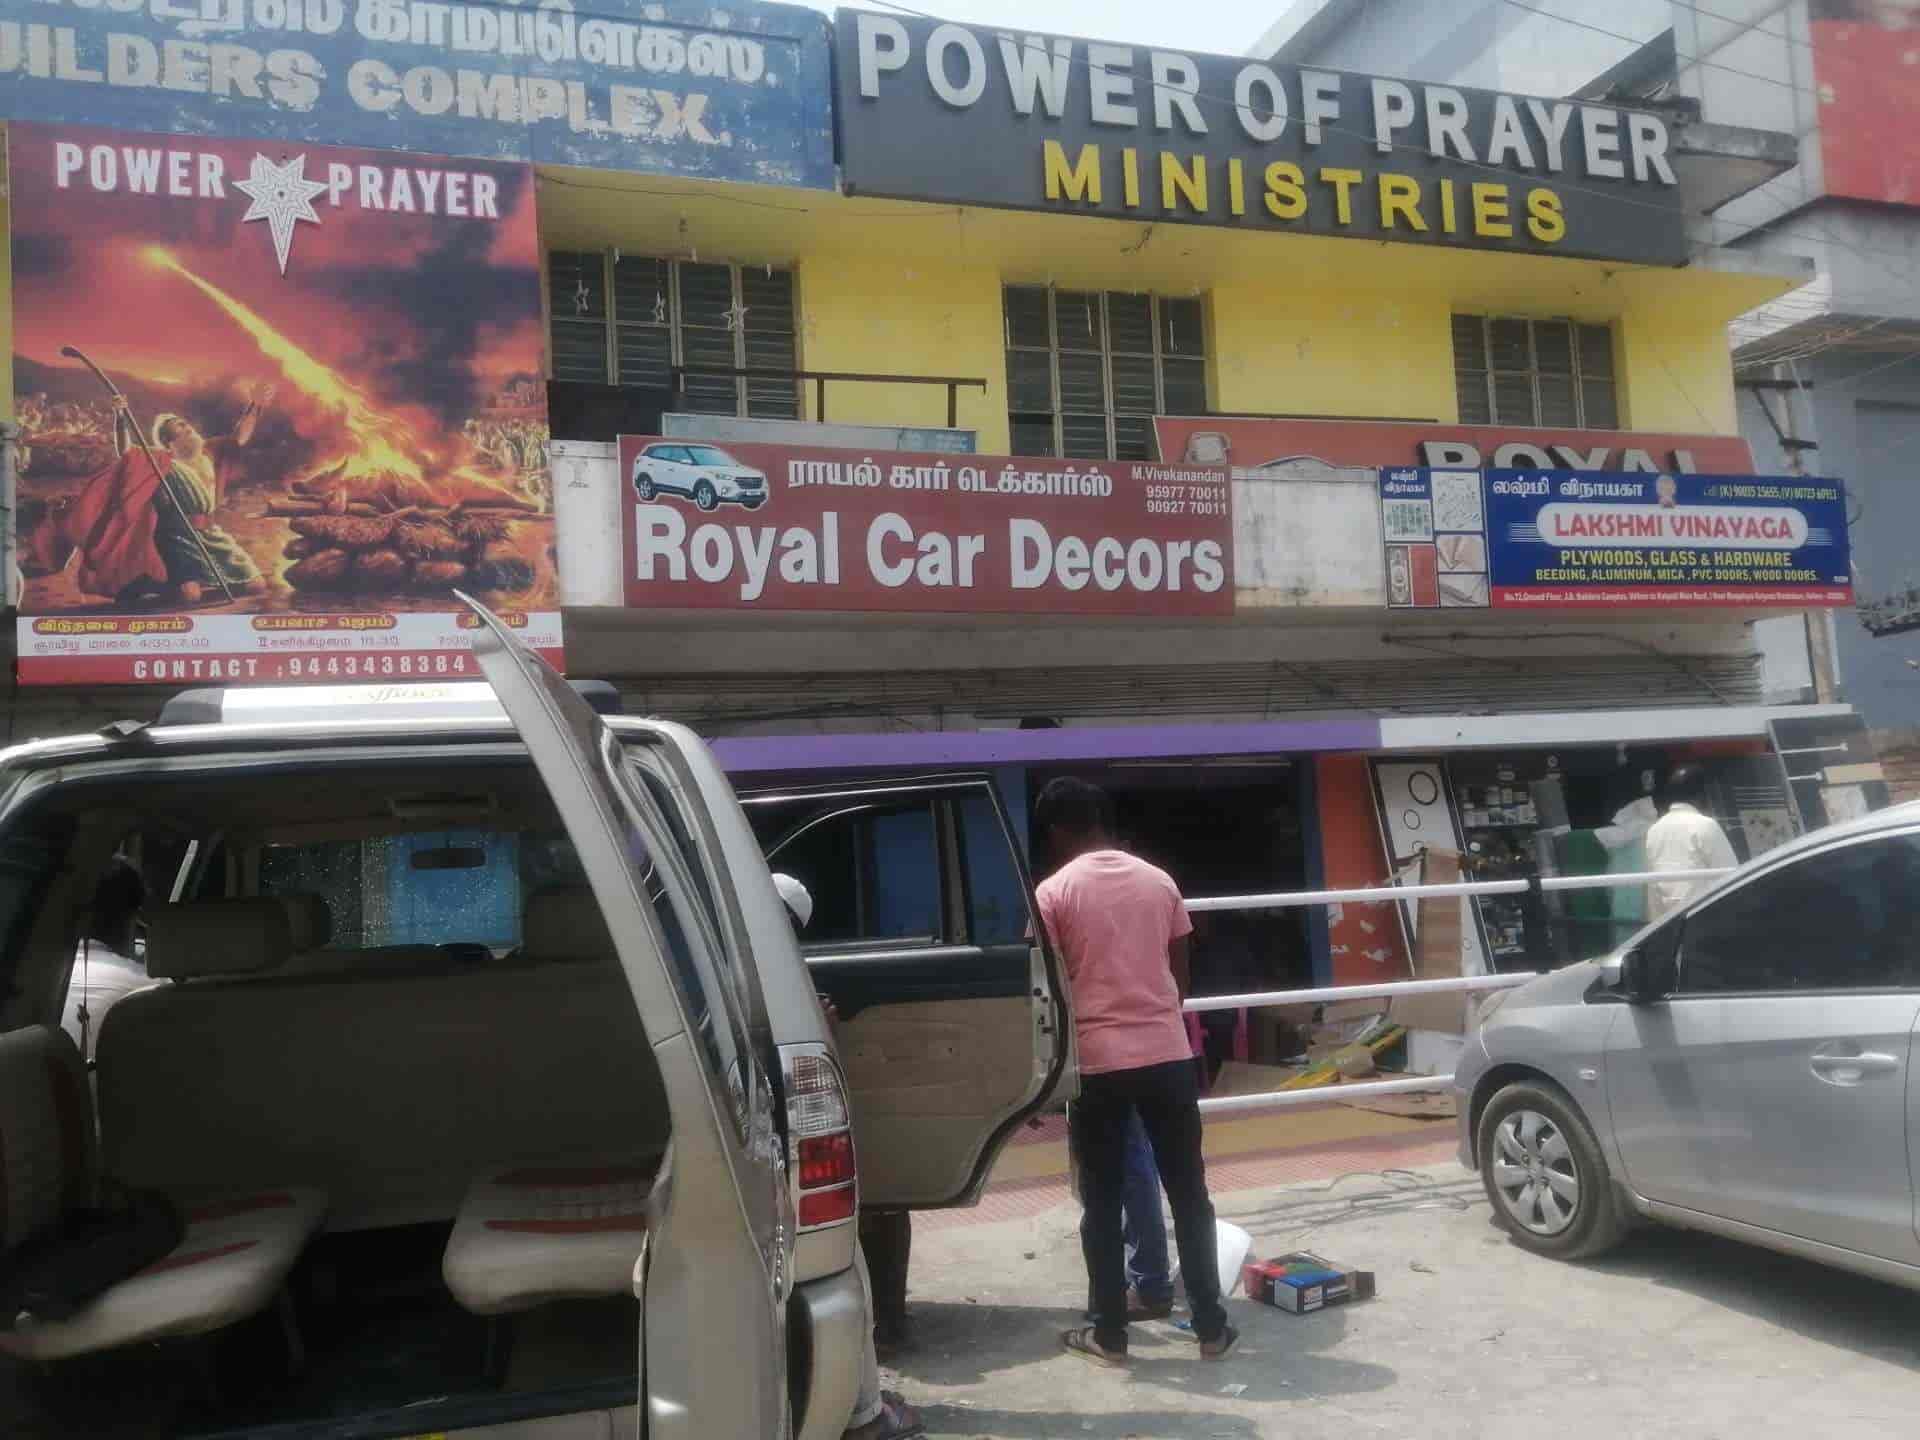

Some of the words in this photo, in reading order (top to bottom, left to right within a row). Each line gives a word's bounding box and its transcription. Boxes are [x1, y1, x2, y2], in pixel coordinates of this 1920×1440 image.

[856, 14, 1208, 134] POWER
[1234, 62, 1342, 145] OF
[1370, 78, 1678, 186] PRAYER
[55, 141, 226, 198] POWER
[327, 162, 500, 219] PRAYER
[1042, 139, 1567, 243] MINISTRIES
[787, 457, 882, 488] ராயல்
[889, 460, 951, 490] கார்
[1189, 486, 1226, 500] 70011
[1189, 502, 1227, 515] 70011
[1553, 513, 1663, 537] LAKSHMI
[1671, 514, 1793, 539] VINAYAGA
[636, 504, 841, 601] Royal
[866, 513, 985, 588] Car
[1010, 518, 1225, 592] Decors
[1650, 551, 1697, 566] GLASS
[1701, 553, 1710, 566] &
[1714, 551, 1793, 567] HARDWARE
[133, 658, 258, 679] CONTACT
